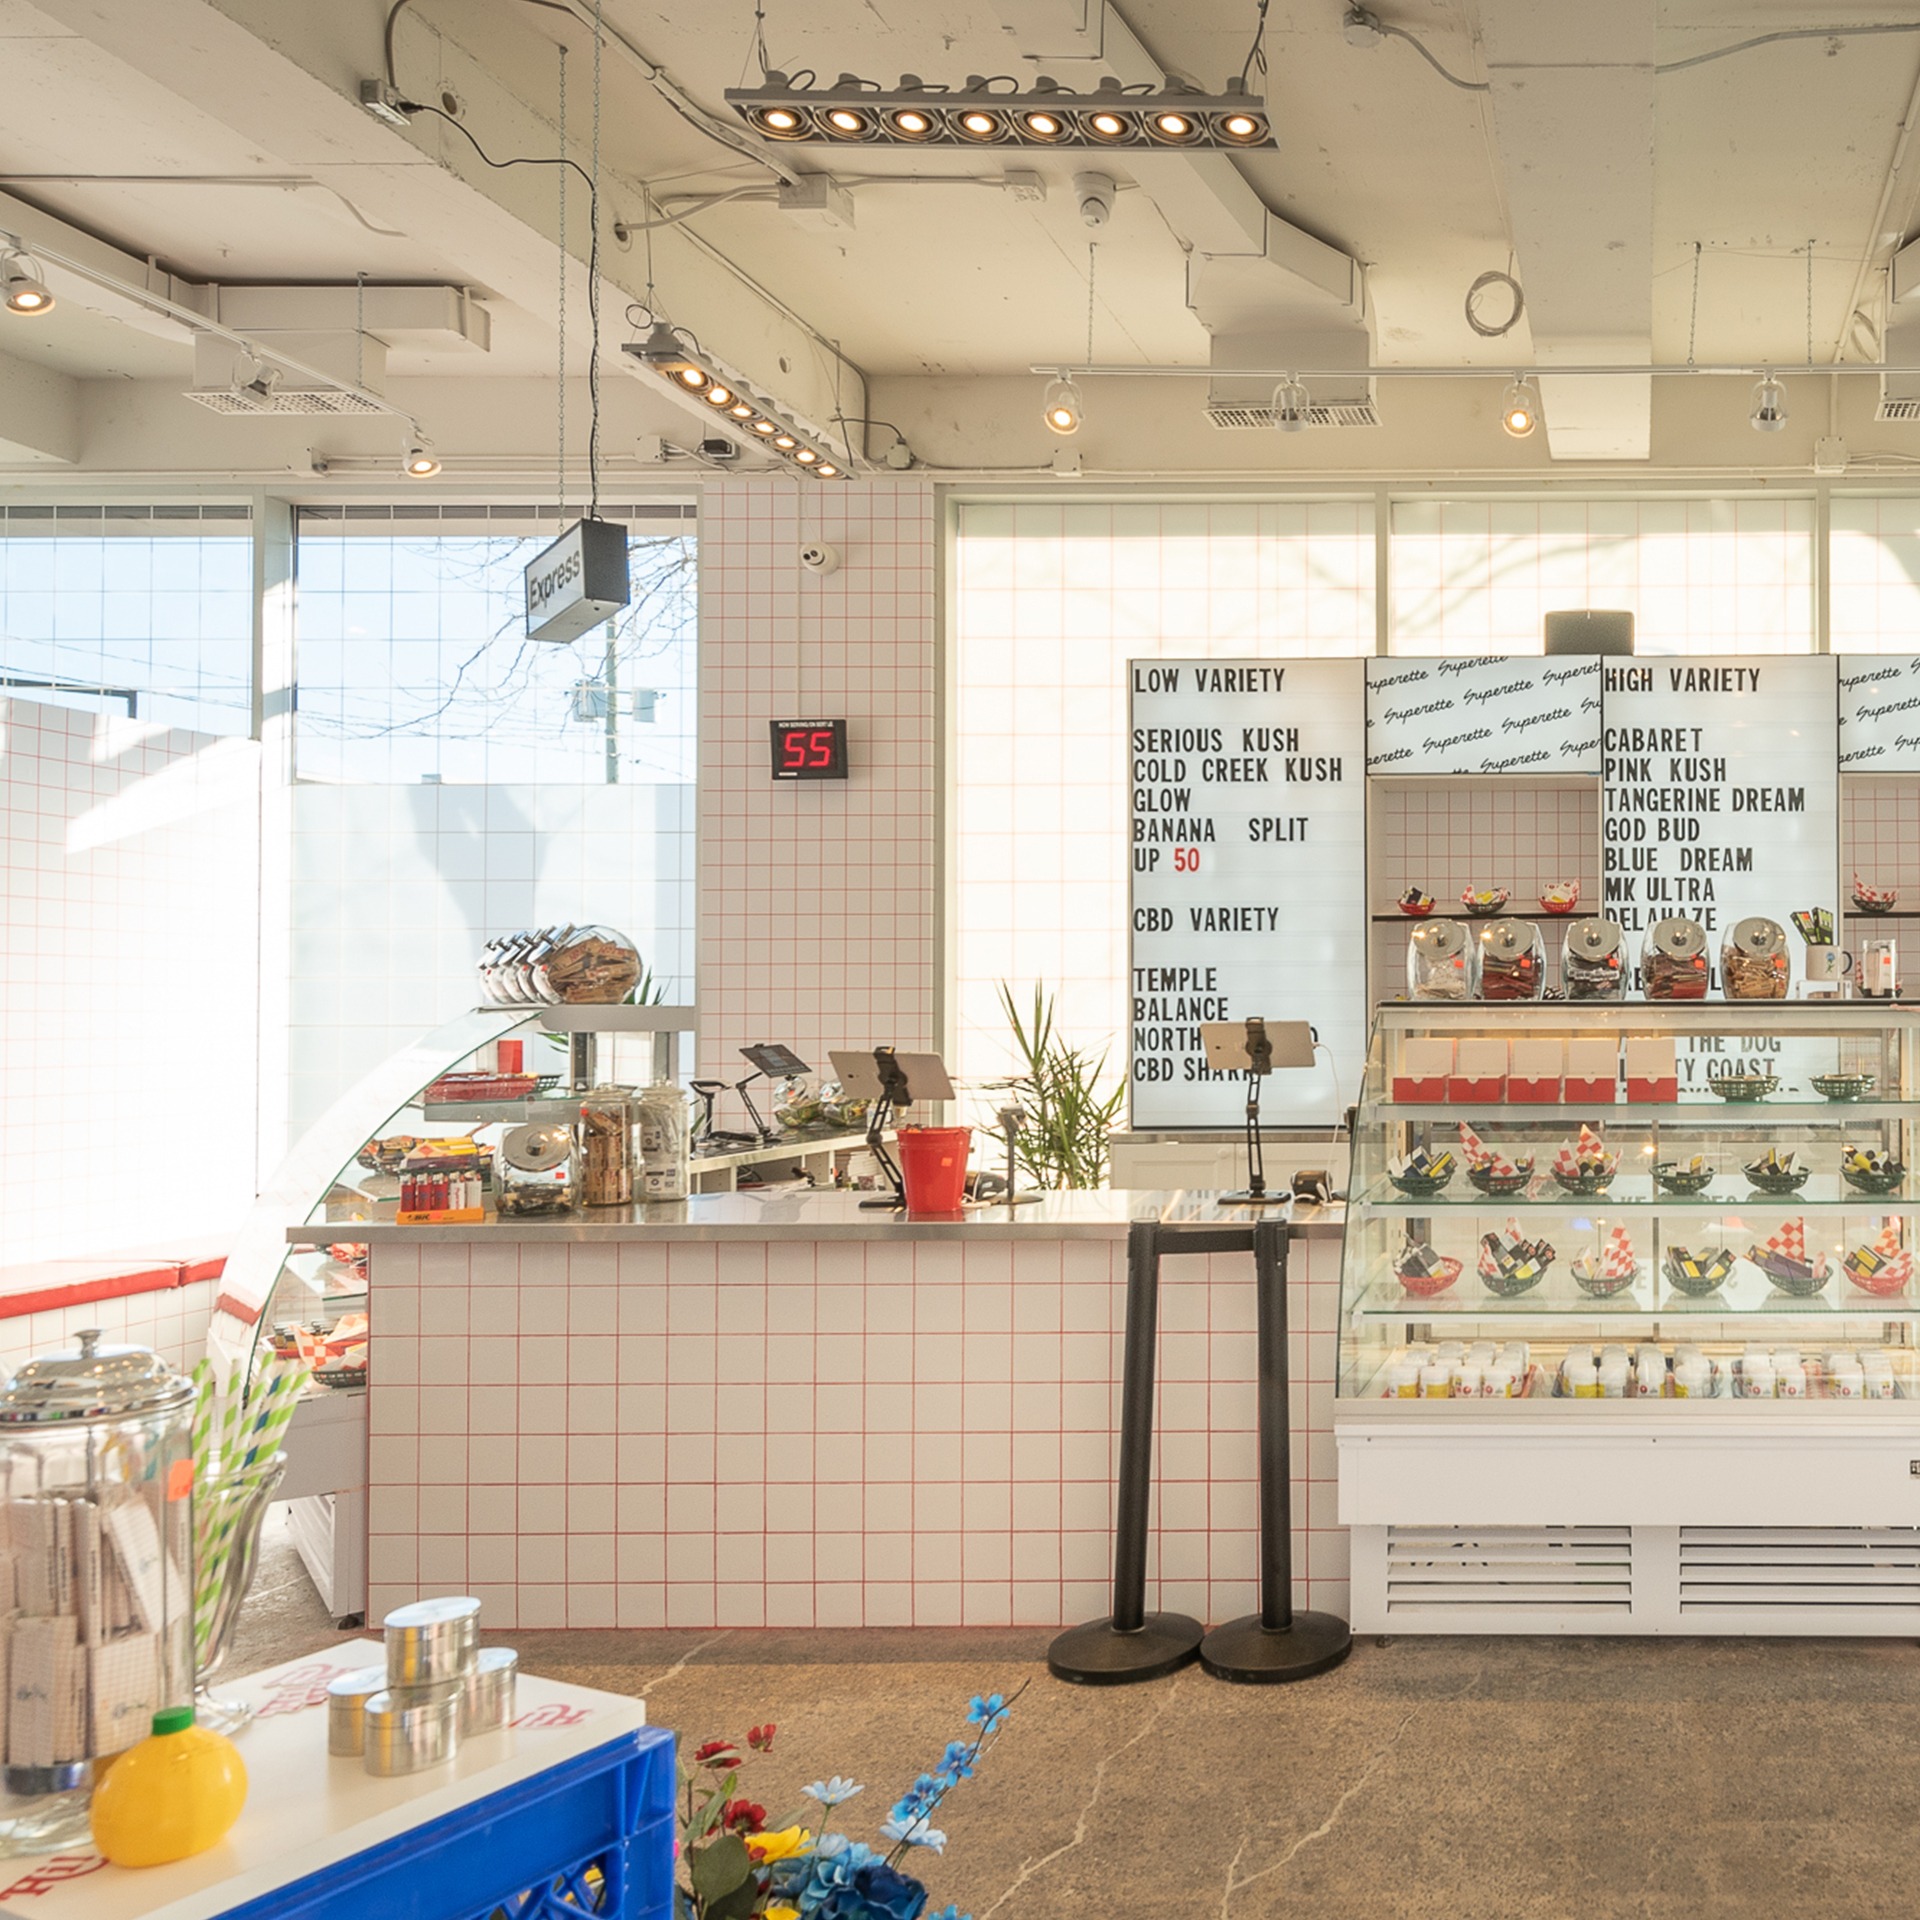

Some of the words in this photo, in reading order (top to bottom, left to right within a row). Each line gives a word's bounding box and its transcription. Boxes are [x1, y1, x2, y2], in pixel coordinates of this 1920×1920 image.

[530, 550, 580, 610] Express
[1135, 669, 1179, 692] LOW
[1196, 668, 1284, 692] VARIETY
[1366, 670, 1428, 695] uperette
[1605, 668, 1652, 691] HIGH
[1670, 668, 1760, 692] VARIETY
[1839, 667, 1902, 692] uperette
[1384, 699, 1454, 725] Superette
[1463, 680, 1534, 705] Superette
[1543, 661, 1601, 687] Superet
[1133, 729, 1222, 752] SERIOUS
[1243, 728, 1298, 752] KUSH
[1366, 748, 1414, 766] perette
[1422, 728, 1493, 754] Superette
[1501, 708, 1572, 734] Superette
[1604, 728, 1702, 752] CABARET
[784, 733, 832, 766] 55
[1839, 745, 1886, 764] perette
[1133, 759, 1186, 782] COLD
[1203, 758, 1268, 782] CREEK
[1286, 758, 1341, 781] KUSH
[1480, 750, 1551, 774] Superette
[1605, 758, 1651, 781] PINK
[1671, 758, 1725, 781] KUSH
[1133, 788, 1190, 812] GLOW
[1604, 788, 1720, 811] TANGERINE
[1733, 788, 1804, 811] DREAM
[1133, 818, 1215, 842] BANANA
[1249, 818, 1308, 841] SPLIT
[1605, 818, 1645, 841] GOD
[1659, 818, 1699, 841] BUD
[1134, 848, 1159, 872] UP
[1175, 848, 1199, 872] 50
[1604, 848, 1657, 871] BLUE
[1681, 848, 1752, 871] DREAM
[1605, 878, 1635, 901] MK
[1647, 877, 1714, 901] ULTRA
[1133, 908, 1173, 931] CBD
[1190, 908, 1278, 931] VARIETY
[1133, 968, 1216, 991] TEMPLE
[1133, 997, 1228, 1021] BALANCE
[1135, 1027, 1201, 1051] NORTH
[1134, 1058, 1173, 1081] CBD
[1707, 1059, 1774, 1077] COAST
